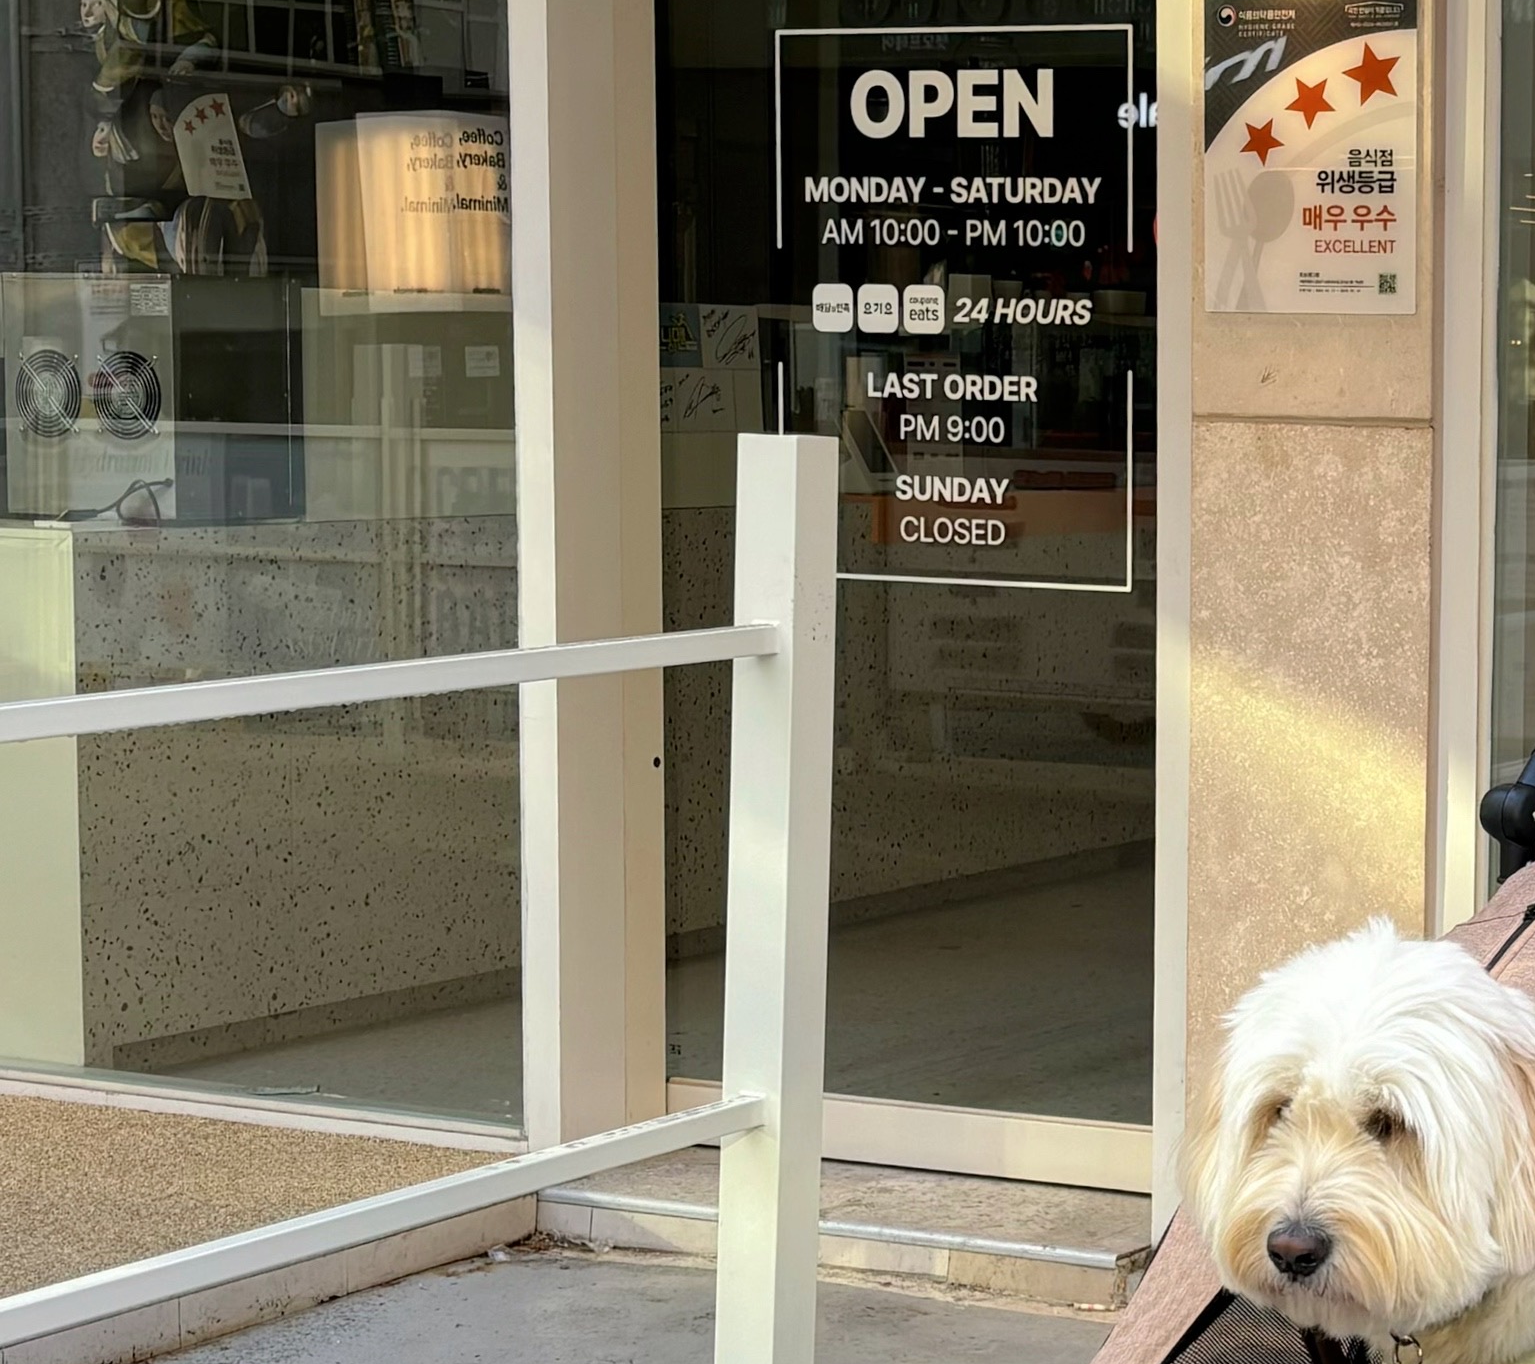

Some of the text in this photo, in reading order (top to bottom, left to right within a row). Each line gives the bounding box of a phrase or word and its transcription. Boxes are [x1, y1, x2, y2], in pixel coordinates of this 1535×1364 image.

[850, 68, 1054, 138] OPEN
[1347, 148, 1394, 168] 음식점
[804, 175, 927, 204] MONDAY
[949, 176, 1102, 205] SATURDAY
[1316, 170, 1397, 195] 위생등급
[821, 218, 864, 245] AM
[870, 218, 941, 246] 10:00
[965, 219, 1006, 246] PM
[1013, 219, 1086, 247] 10:00
[1302, 204, 1397, 232] 매우 우수
[1314, 239, 1397, 254] EXCELLENT
[862, 301, 894, 316] 요기요
[909, 306, 940, 322] eats
[953, 297, 1094, 326] 24 HOURS
[866, 372, 1039, 403] LAST ORDER
[899, 413, 1006, 444] PM 9:00
[895, 474, 1010, 505] SUNDAY
[899, 515, 1006, 546] CLOSED
